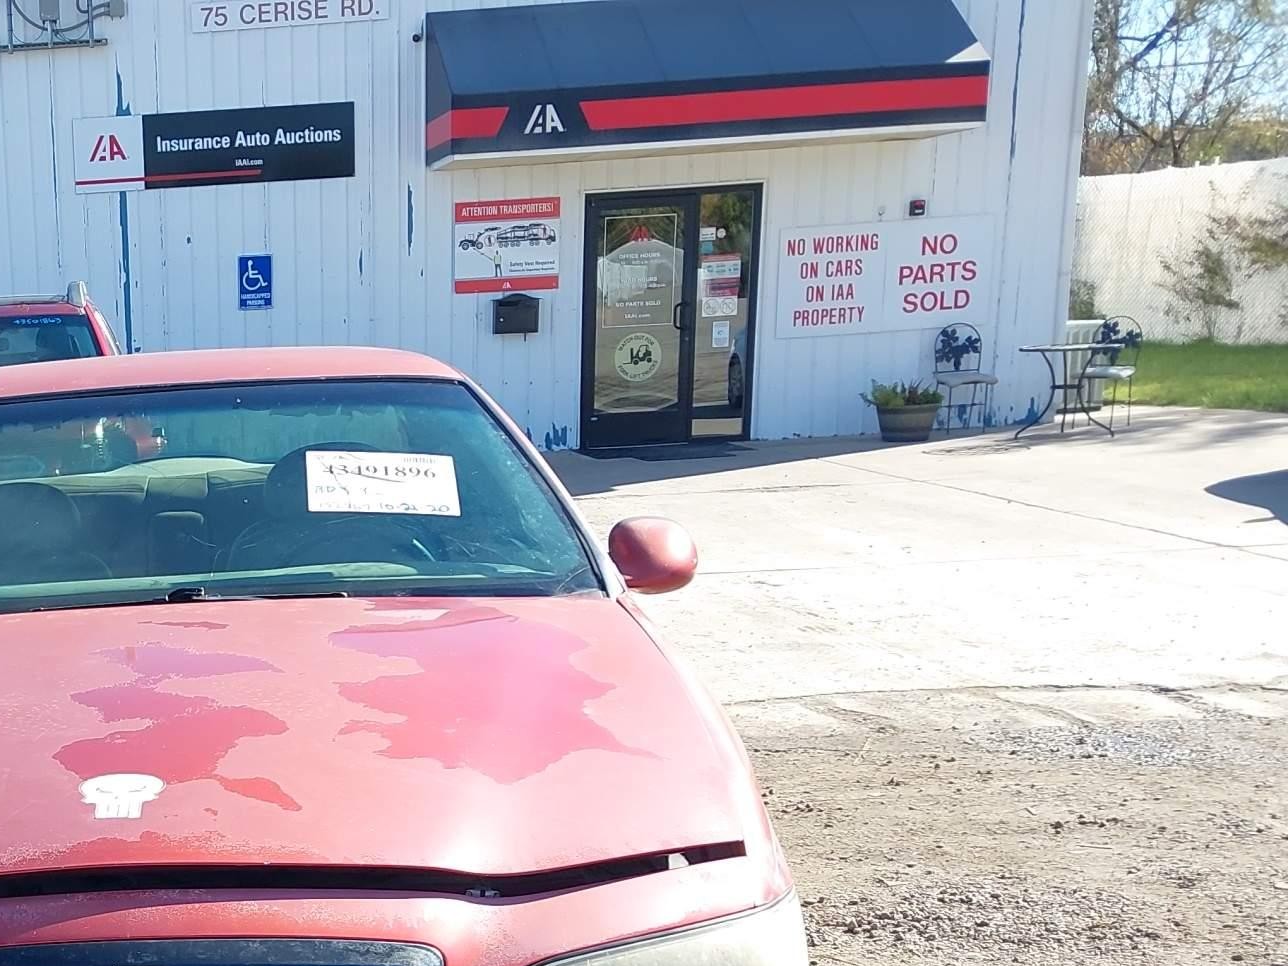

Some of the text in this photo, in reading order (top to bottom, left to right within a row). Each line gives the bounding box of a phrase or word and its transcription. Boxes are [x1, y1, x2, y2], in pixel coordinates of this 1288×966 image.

[200, 0, 380, 27] 75 CERISE RD.
[156, 125, 342, 153] Insurance Auto Auctions
[461, 202, 554, 217] ATTENTION TRANSPORTERS!
[787, 233, 879, 256] NO WORKING
[921, 233, 958, 256] NO
[800, 258, 863, 280] ON CARS
[898, 260, 978, 286] PARTS
[805, 283, 855, 303] ON IAA
[902, 289, 971, 314] SOLD
[792, 306, 865, 327] PROPERTY
